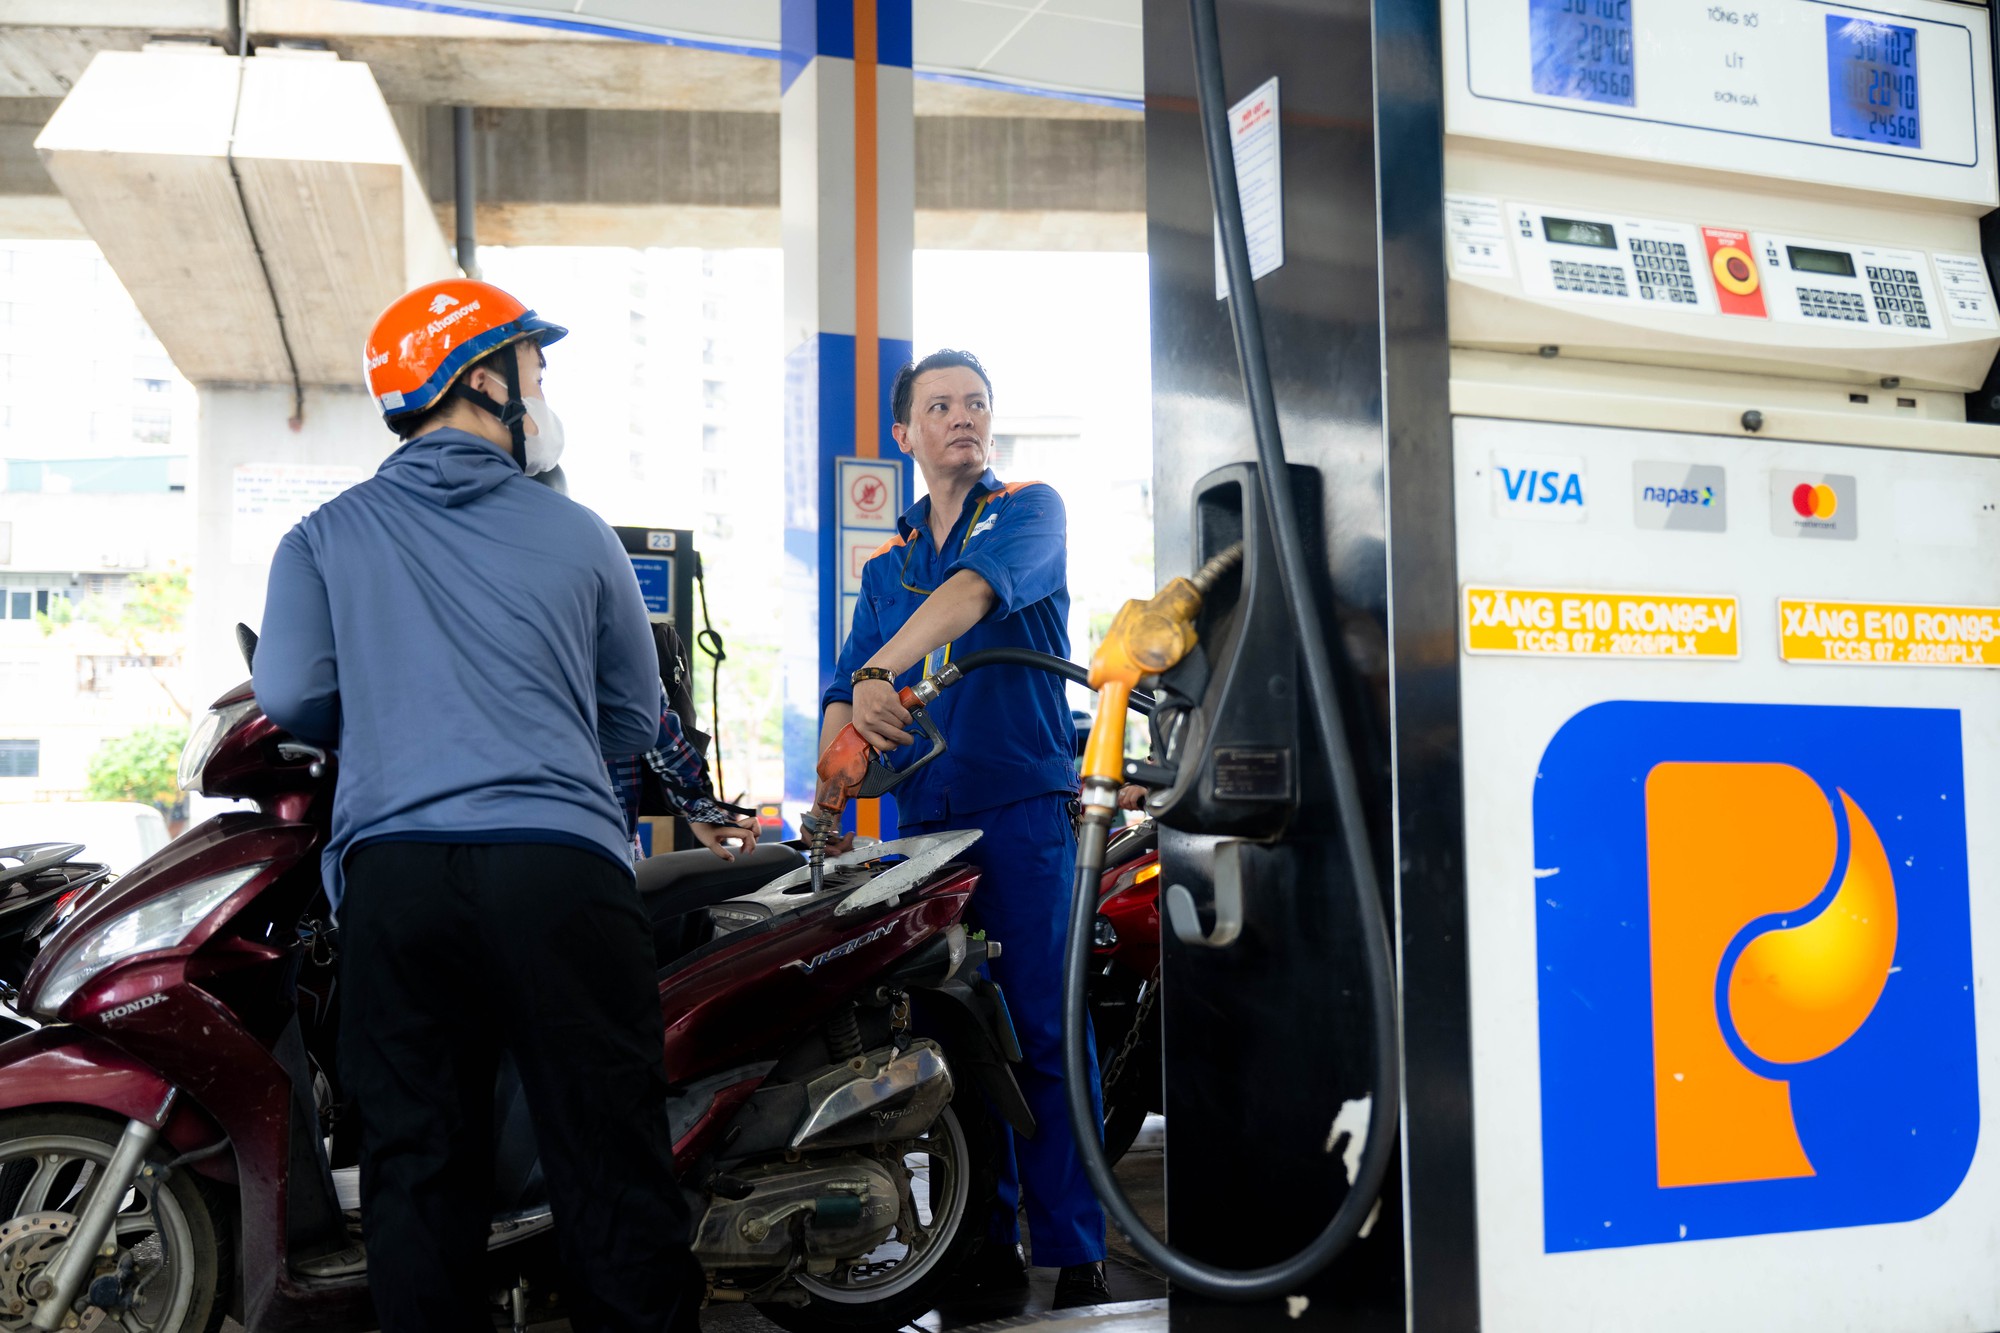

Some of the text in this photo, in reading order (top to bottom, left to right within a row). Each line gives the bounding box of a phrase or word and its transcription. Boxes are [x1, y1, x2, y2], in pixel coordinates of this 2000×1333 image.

[1743, 13, 1759, 28] SỐ
[1725, 52, 1744, 69] LÍT
[1576, 67, 1632, 98] 24560
[1868, 68, 1915, 111] 2040
[1868, 111, 1916, 140] 24560
[426, 300, 481, 338] Ahamove
[1495, 467, 1584, 506] VISA
[1643, 486, 1699, 508] napas
[652, 535, 671, 548] 23
[1471, 591, 1735, 634] XĂNG E10 RON95-V
[1784, 603, 2000, 643] XĂNG E10 RON95-
[1513, 630, 1569, 651] TCCS
[1572, 632, 1595, 651] 07
[1610, 634, 1698, 655] 2026/PLX
[1822, 640, 1872, 661] TCCS
[1874, 642, 1895, 661] 07
[1907, 643, 1985, 663] 2026/PLX
[780, 919, 900, 975] VISION
[100, 992, 170, 1023] HONDA
